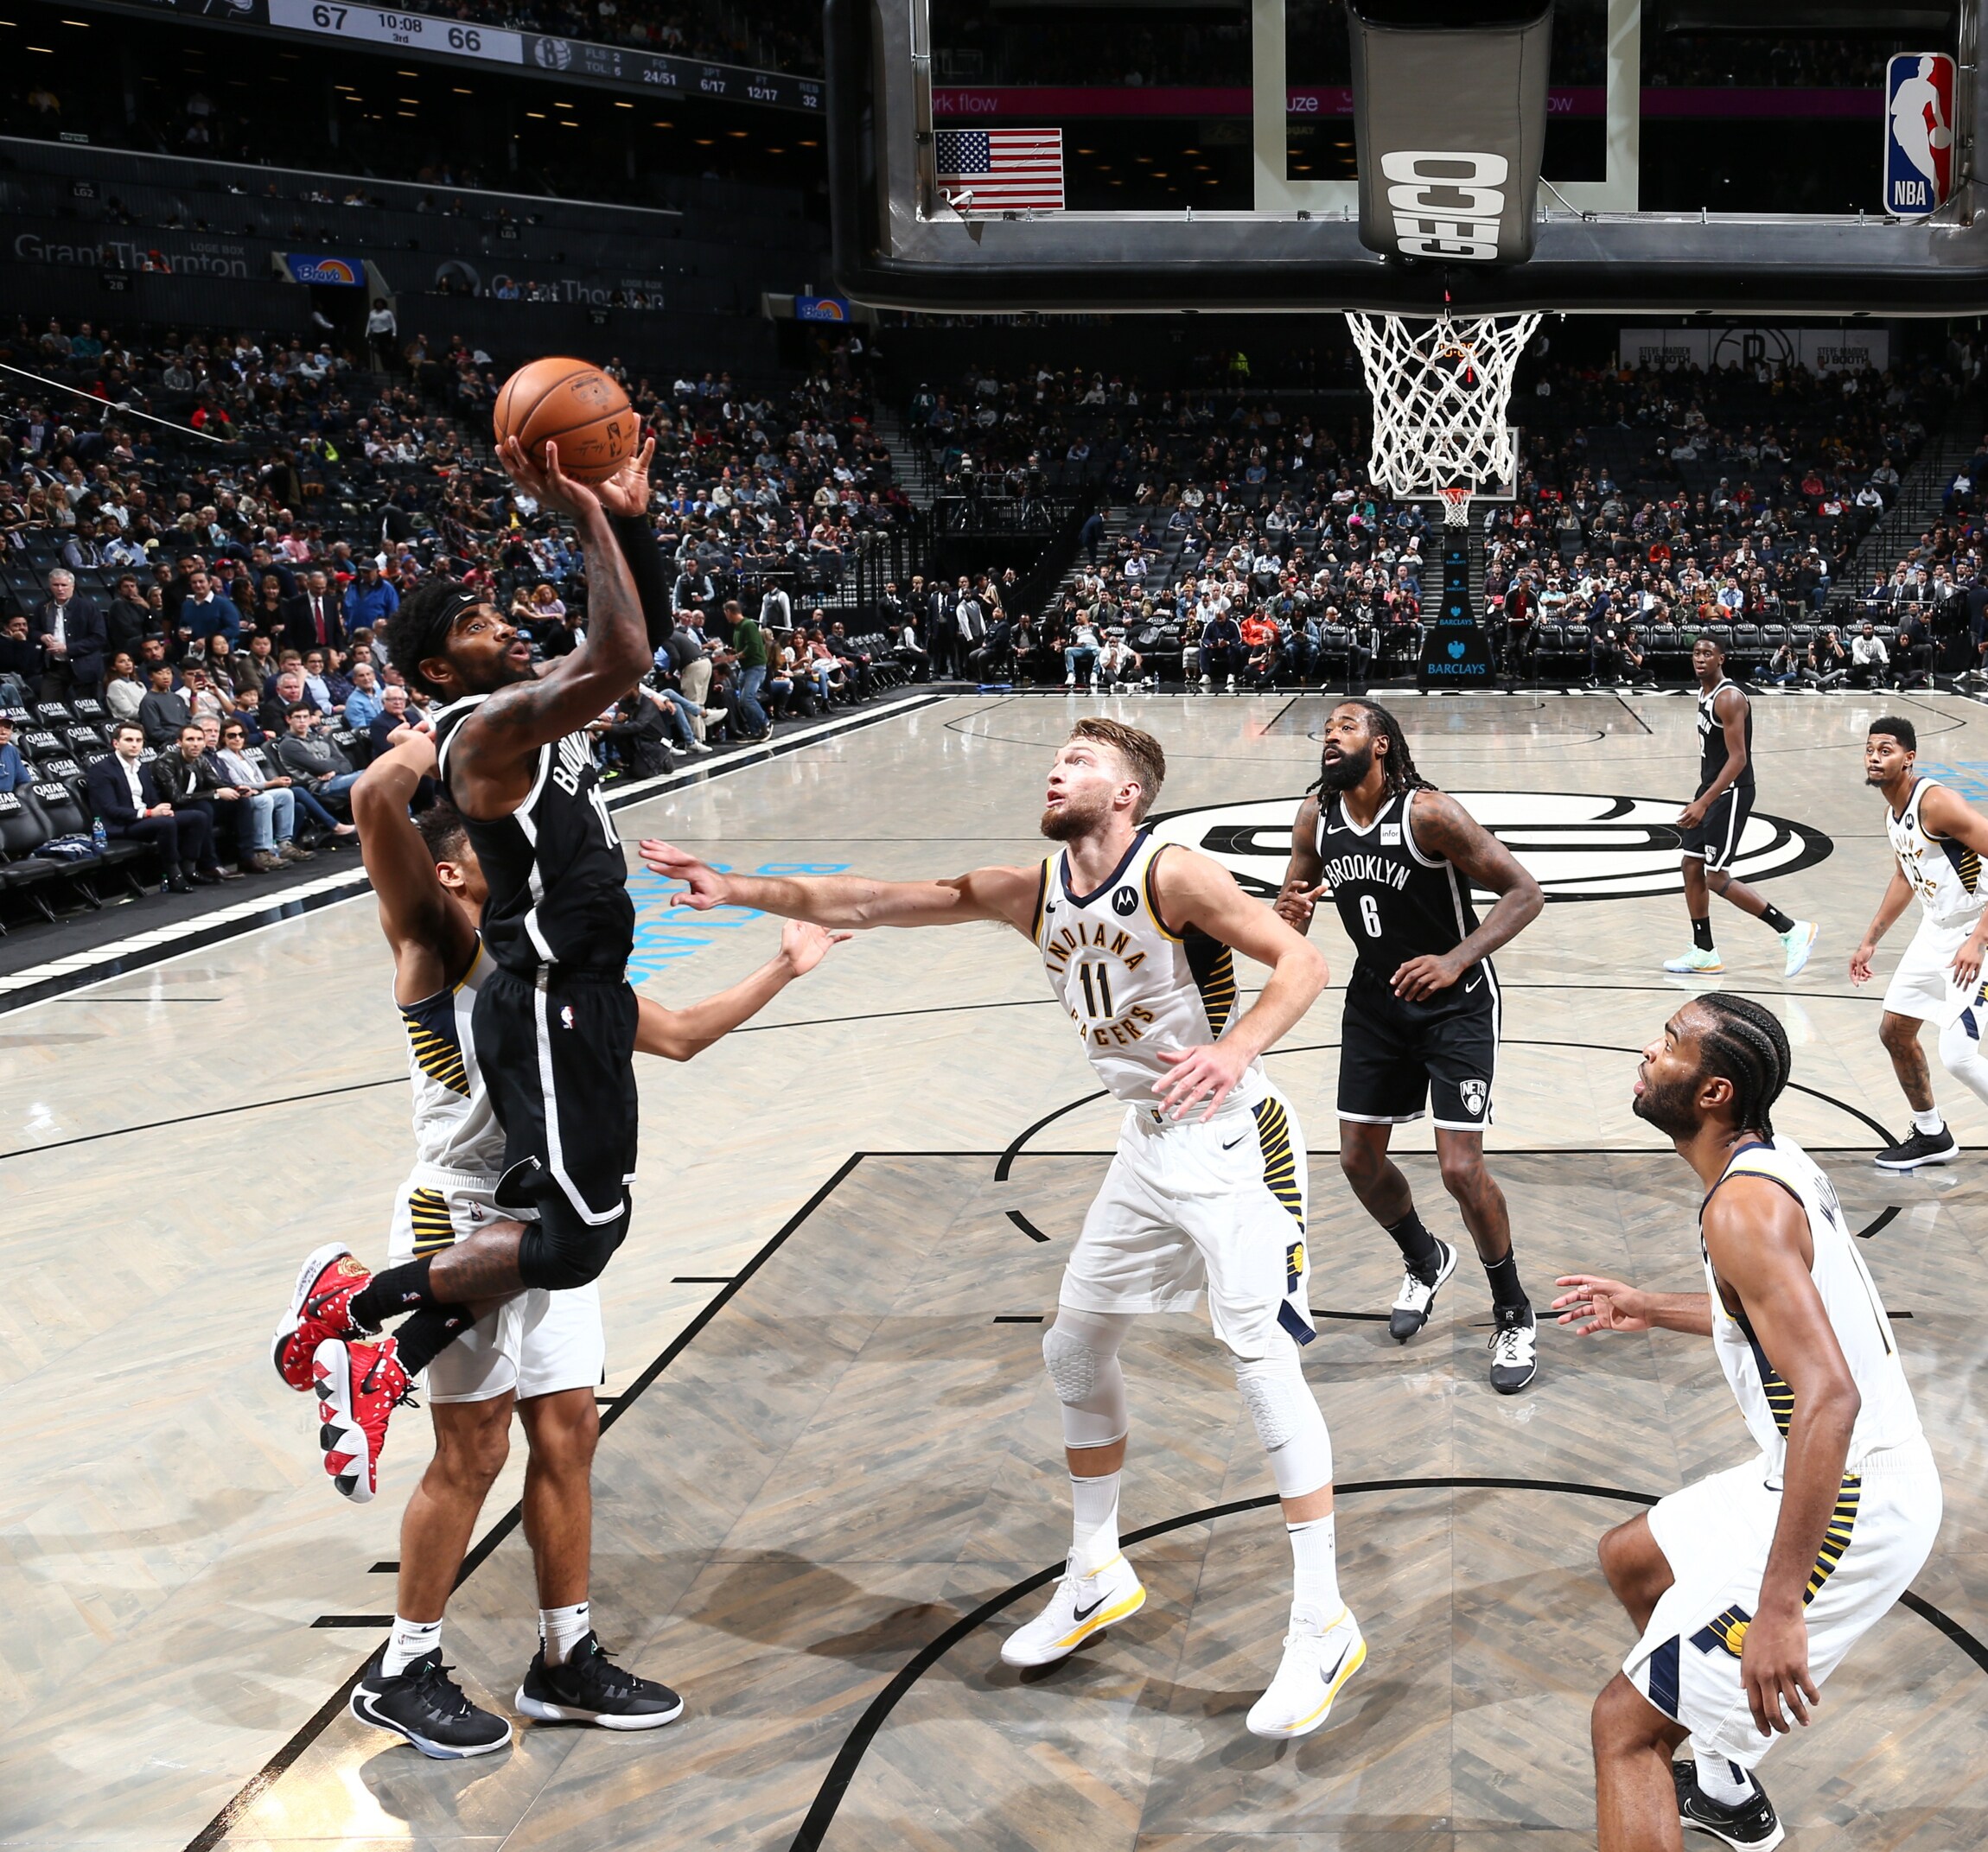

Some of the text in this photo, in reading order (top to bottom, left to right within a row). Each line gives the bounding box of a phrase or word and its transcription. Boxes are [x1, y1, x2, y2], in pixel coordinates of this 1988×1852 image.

[312, 4, 347, 30] 67
[378, 13, 423, 33] 10:08
[392, 33, 410, 43] 3rd
[448, 28, 481, 52] 66
[613, 52, 621, 63] 2
[652, 58, 667, 70] FG
[643, 69, 677, 86] 24/51
[702, 67, 722, 79] 3PT
[700, 79, 726, 93] 6/17
[755, 75, 768, 86] FT
[799, 82, 819, 93] REB
[747, 86, 778, 101] 12/17
[802, 95, 818, 108] 32
[959, 92, 997, 112] flow
[73, 188, 95, 198] LG2
[1894, 180, 1927, 206] NBA
[1380, 150, 1508, 259] GEICO
[190, 242, 219, 254] LOGE
[14, 233, 248, 279] Grant Thrnton
[296, 264, 341, 282] Bravo
[801, 303, 834, 320] Bravo
[1639, 347, 1691, 355] STEVE MADDEN
[1817, 347, 1838, 356] STEVE
[1654, 355, 1691, 364] BOOTH
[1428, 664, 1485, 674] BARCLAYS
[7, 706, 28, 716] ATAR
[37, 702, 65, 714] QATAR
[74, 698, 99, 710] QATAR
[25, 732, 56, 744] QATAR
[67, 726, 95, 738] QATAR
[47, 759, 78, 773] QATAR
[32, 782, 67, 797] QATAR
[46, 791, 70, 801] AIRWAYS
[1324, 854, 1411, 891] BROOKLYN
[1360, 894, 1382, 939] 6
[1046, 921, 1147, 974] INDIANA
[1079, 961, 1114, 1020] 11
[1070, 1004, 1155, 1047] PACERS
[1462, 1081, 1486, 1097] NETS
